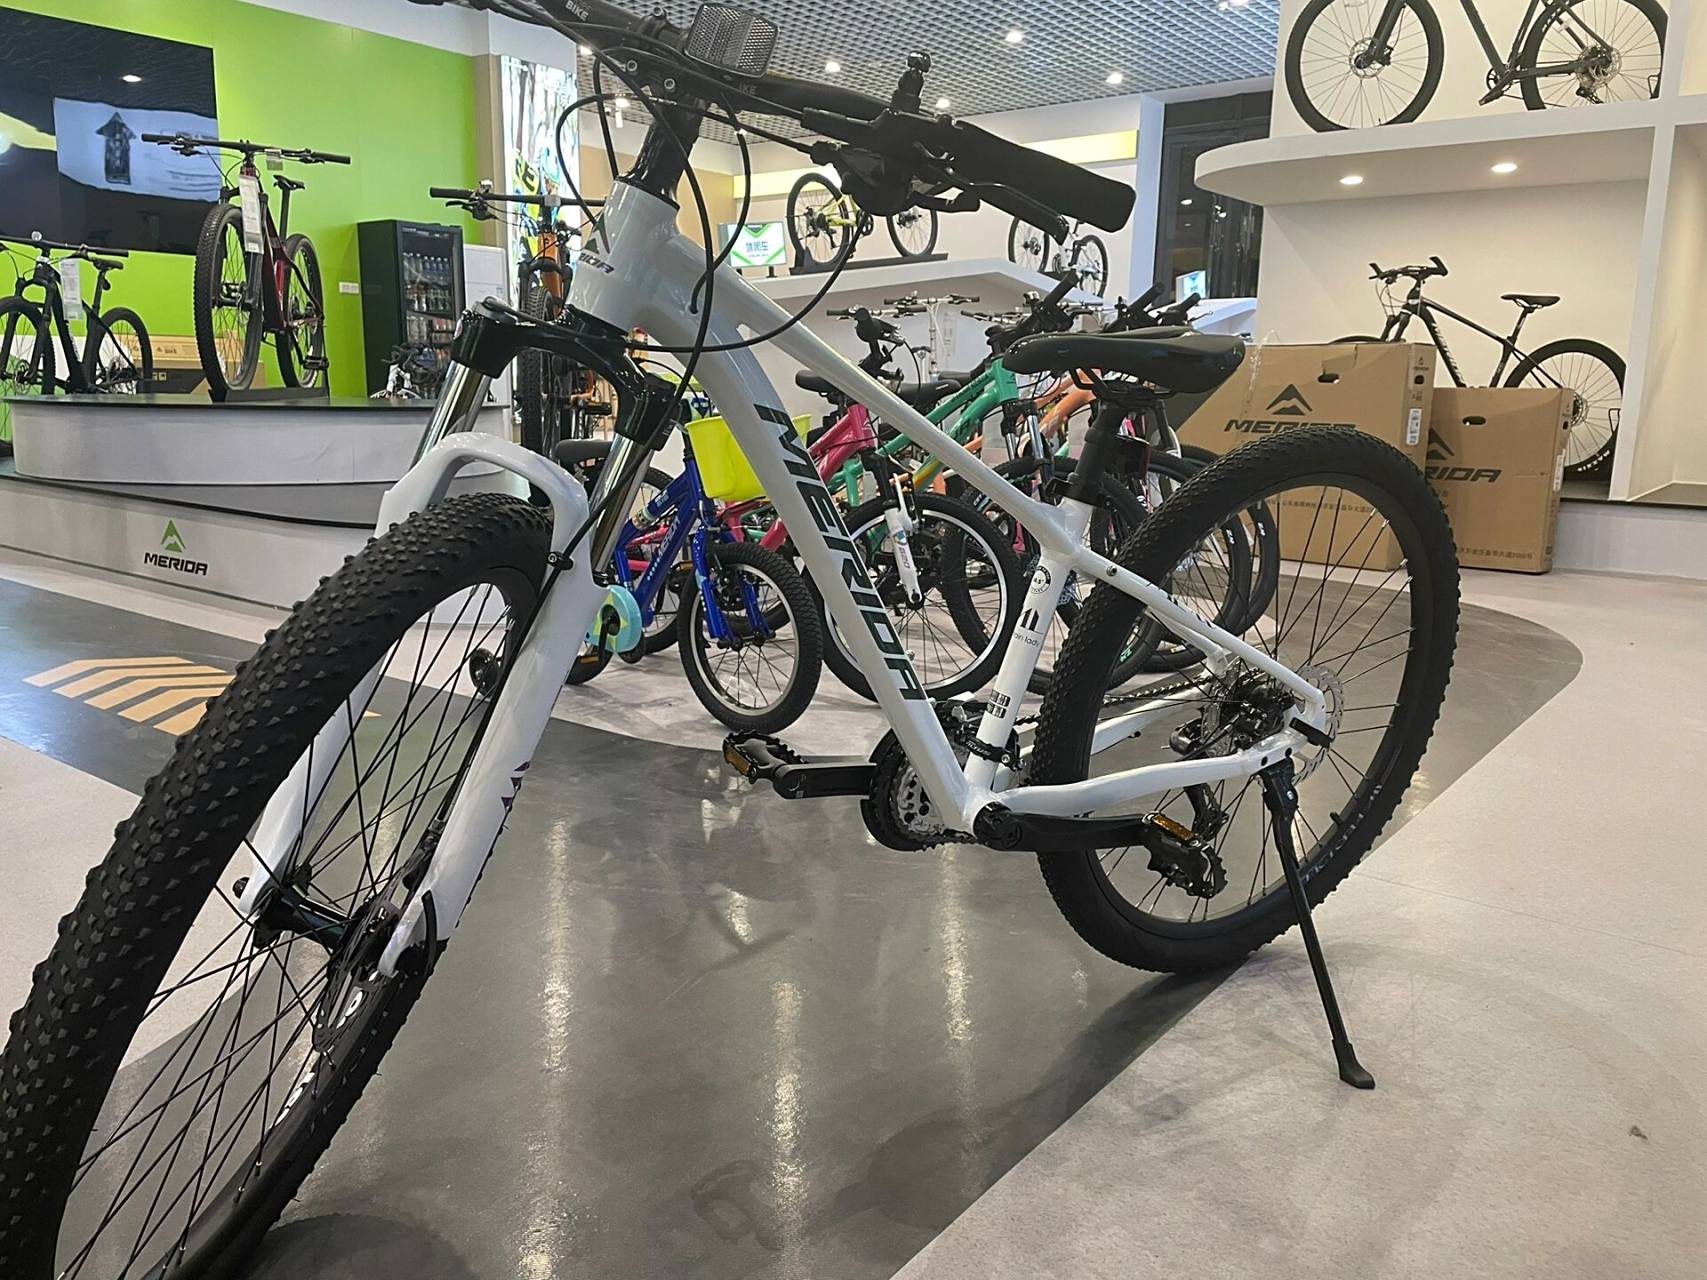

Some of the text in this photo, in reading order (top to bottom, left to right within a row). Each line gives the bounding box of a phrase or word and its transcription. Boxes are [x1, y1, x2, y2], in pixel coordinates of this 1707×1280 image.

[565, 0, 589, 21] BIKE
[1223, 419, 1356, 434] MERI
[1425, 466, 1504, 483] RIDA
[752, 403, 928, 701] MERIDA
[143, 552, 208, 576] MERIDA
